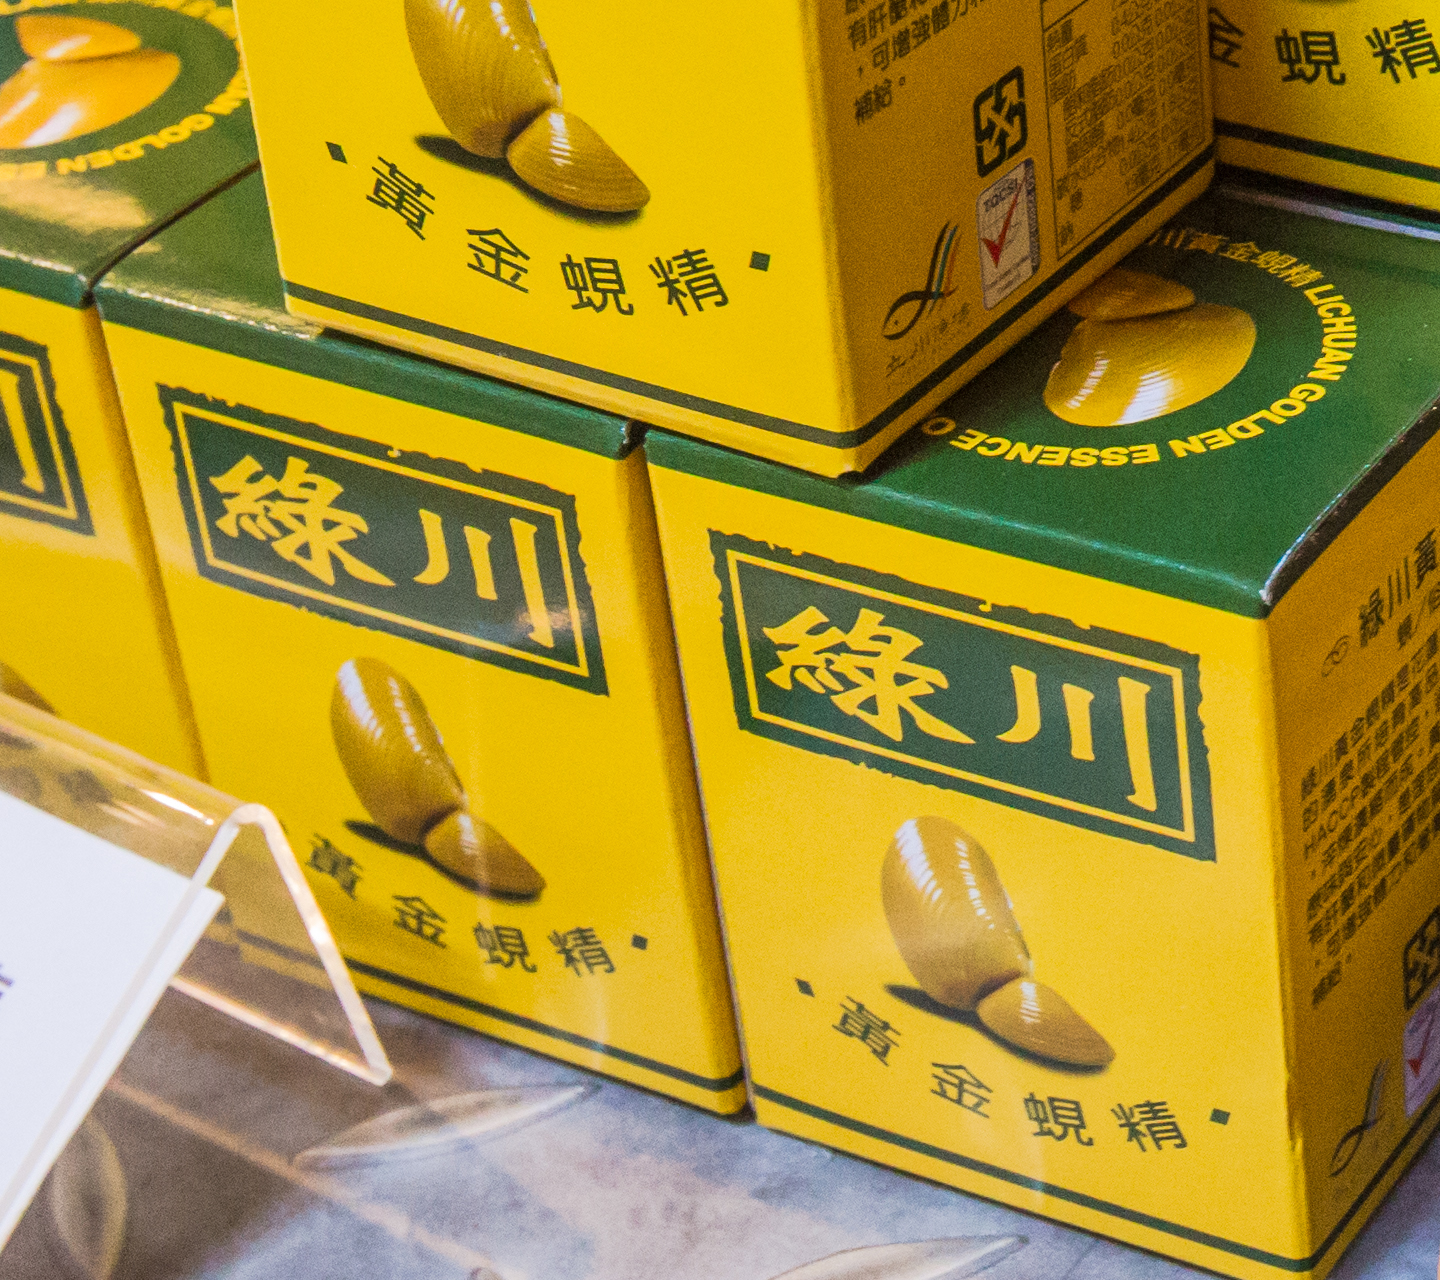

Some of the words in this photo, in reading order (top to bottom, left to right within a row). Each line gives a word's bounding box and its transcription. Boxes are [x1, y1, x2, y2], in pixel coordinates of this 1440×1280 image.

[57, 112, 215, 176] GOLDEN
[366, 156, 729, 317] 黃金蜆精
[1304, 283, 1358, 382] LICHUAN
[950, 428, 1160, 467] ESSENCE
[1169, 382, 1328, 458] GOLDEN
[208, 455, 555, 648] 綠川
[763, 604, 1158, 813] 綠川
[305, 832, 616, 977] 黃金蜆精
[831, 995, 1188, 1153] 黃金蜆精
